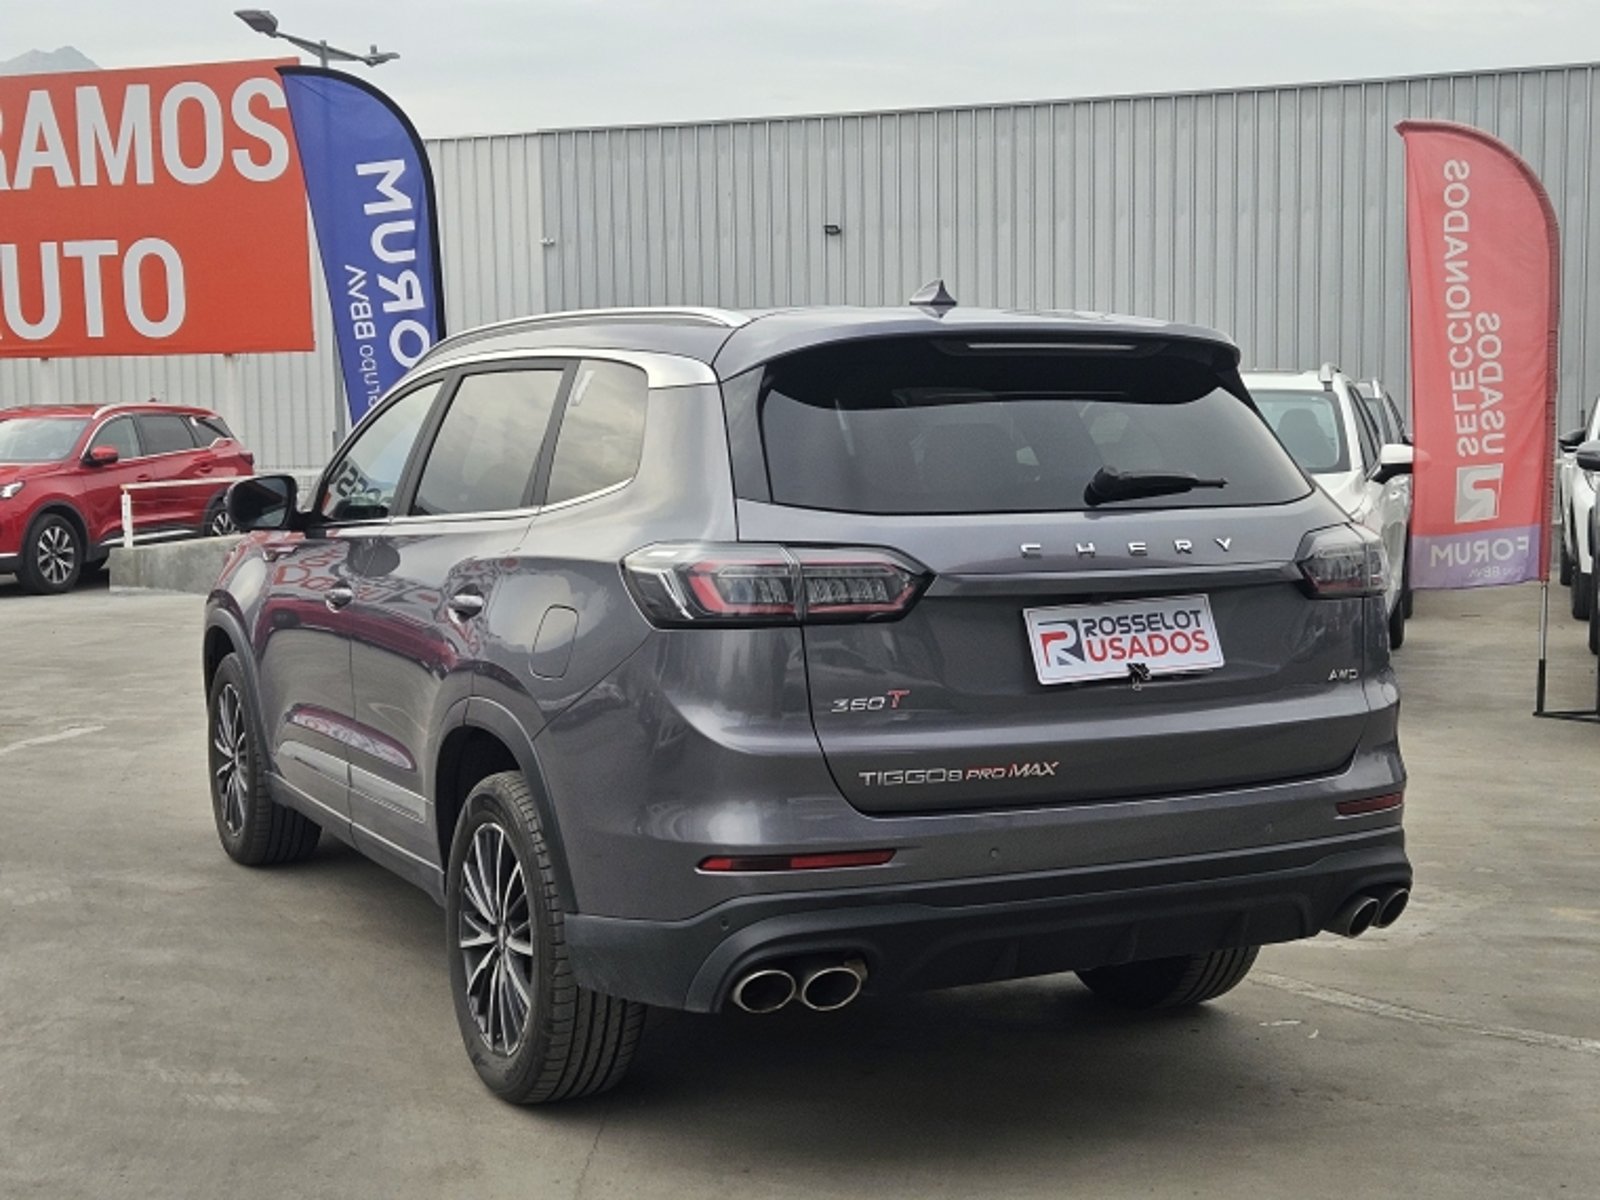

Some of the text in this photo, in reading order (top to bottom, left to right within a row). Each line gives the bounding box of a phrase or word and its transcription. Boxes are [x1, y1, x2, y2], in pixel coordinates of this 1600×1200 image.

[0, 237, 187, 341] UTO
[1020, 537, 1233, 558] CHERY
[1082, 609, 1203, 638] ROSSELOT
[1086, 629, 1210, 663] USADOS
[1328, 668, 1359, 681] AWD
[965, 767, 1006, 781] PRO
[1008, 761, 1060, 778] MAX
